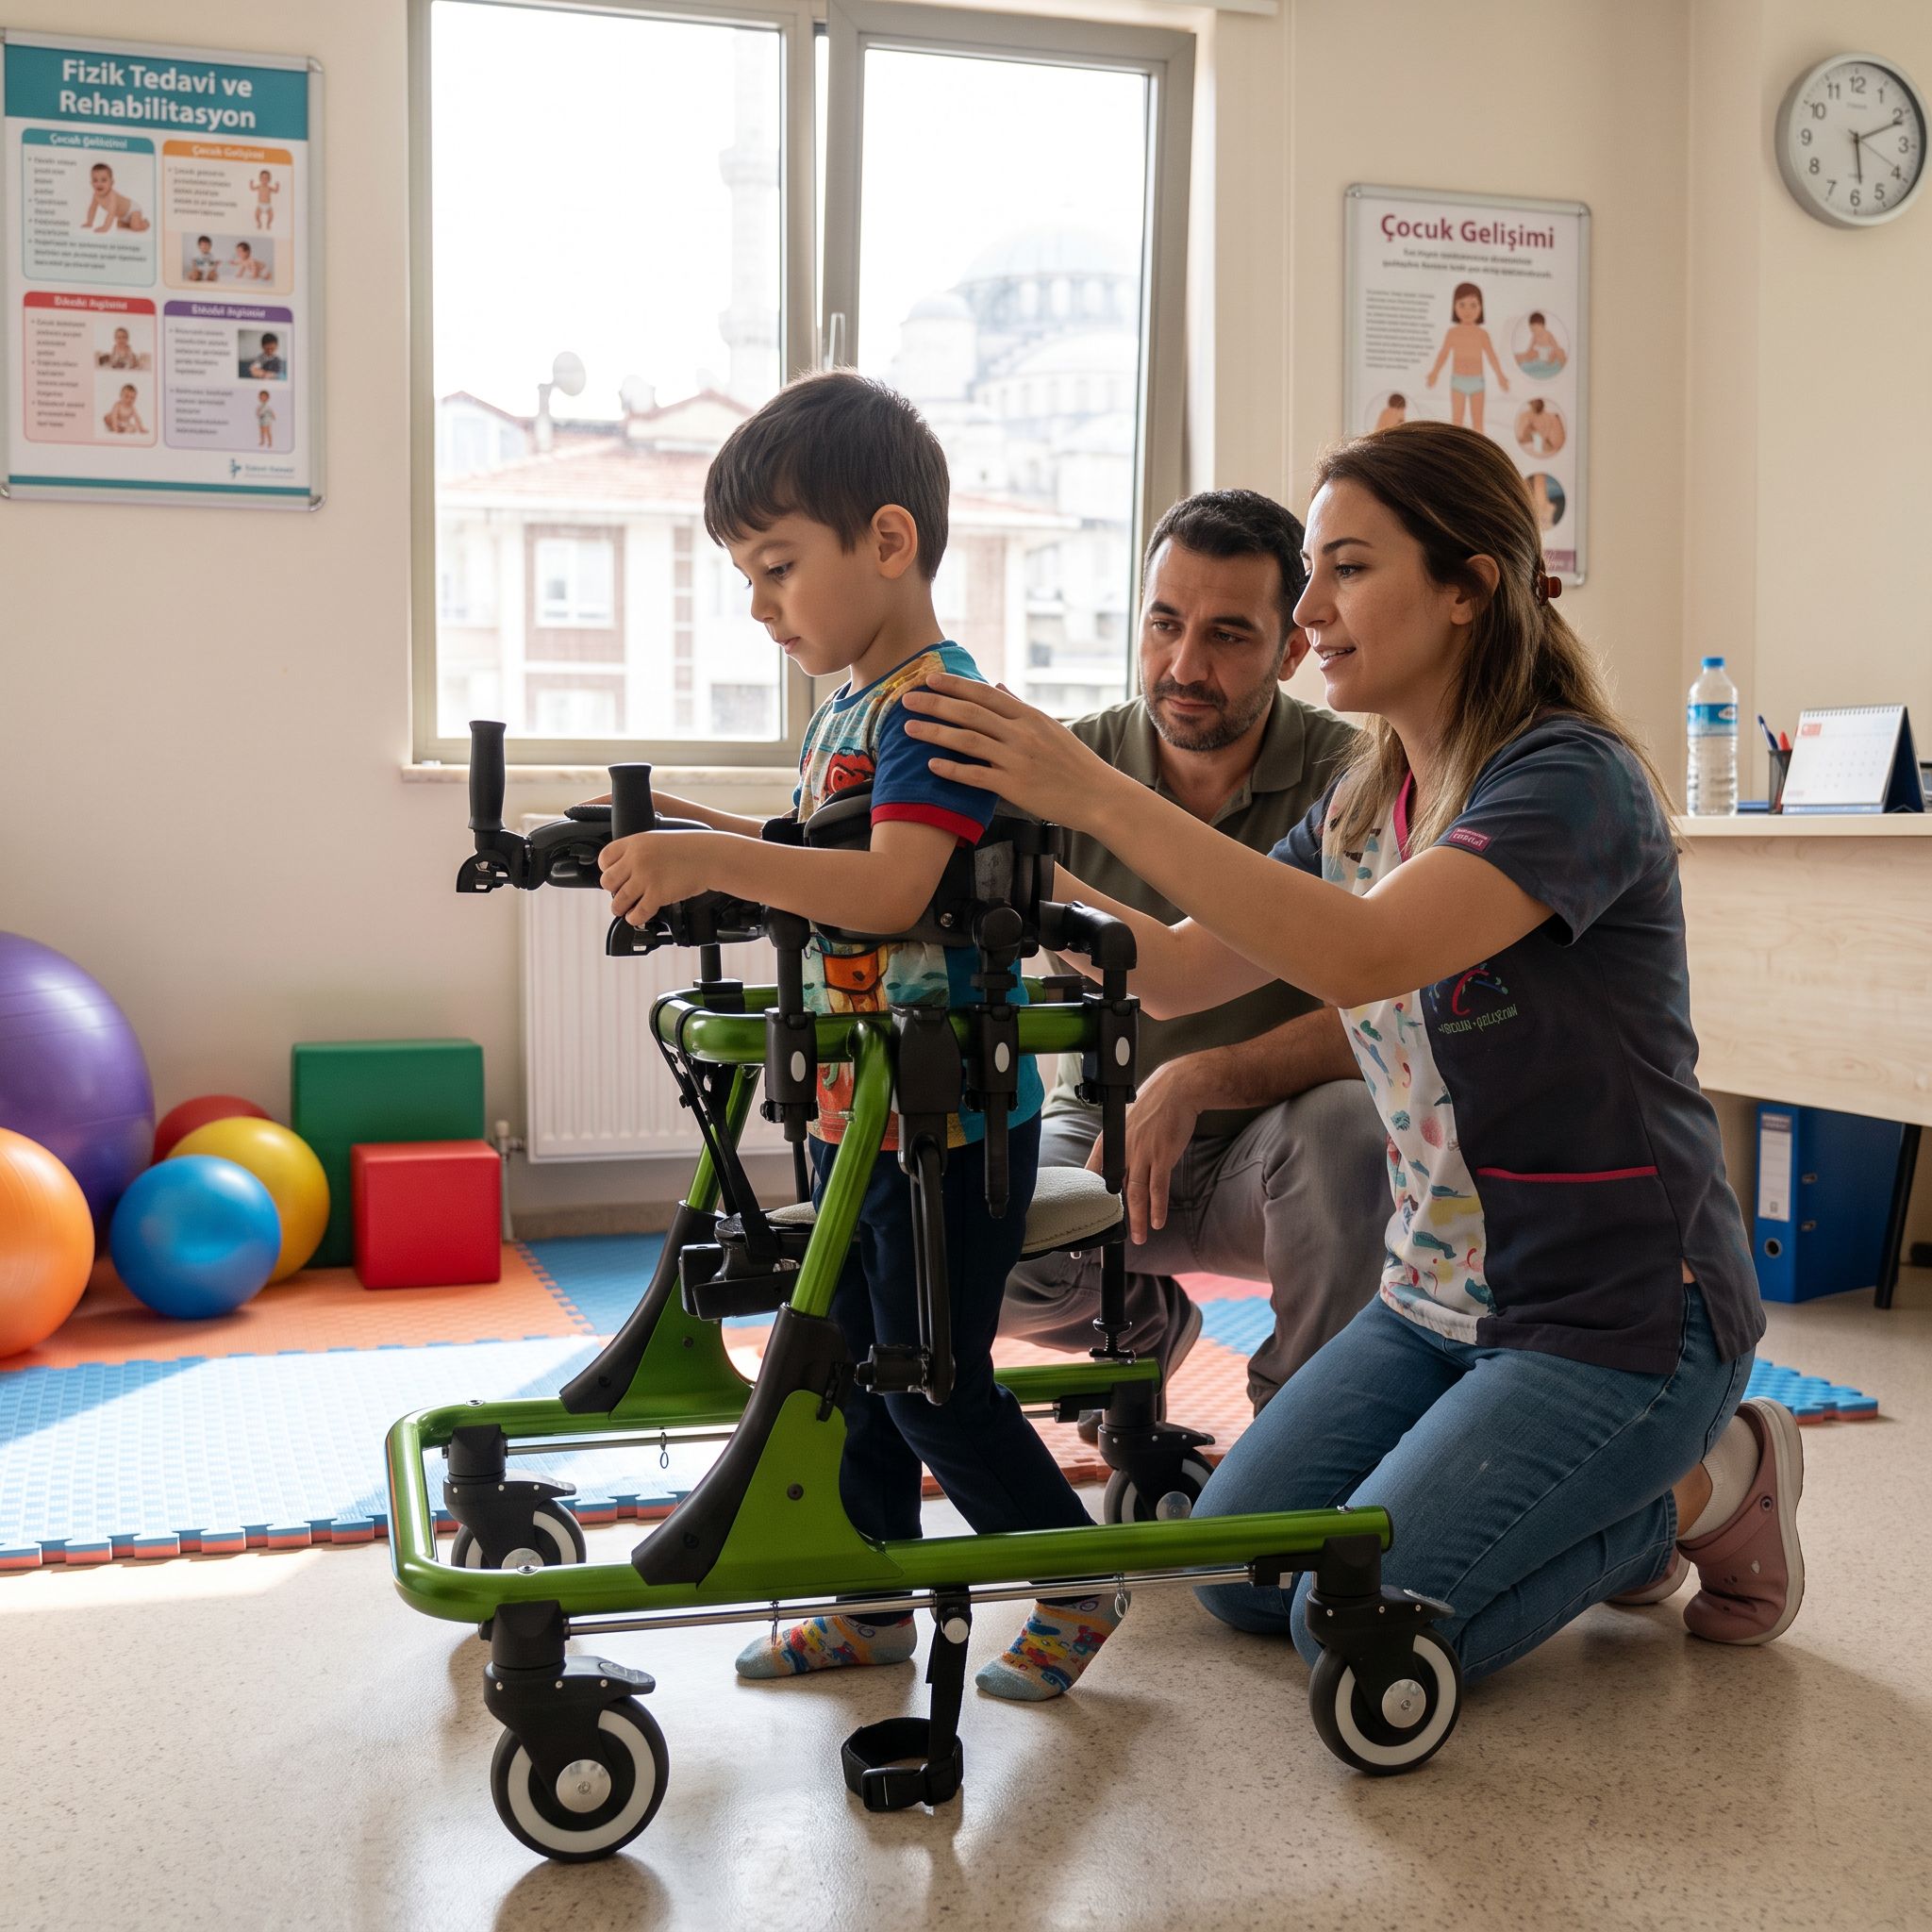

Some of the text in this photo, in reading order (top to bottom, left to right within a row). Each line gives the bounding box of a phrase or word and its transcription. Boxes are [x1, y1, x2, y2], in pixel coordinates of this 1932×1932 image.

[62, 58, 253, 97] Fizik Tedavi ve
[1849, 75, 1866, 94] 12
[1827, 82, 1840, 100] 11
[1877, 88, 1884, 104] 1
[59, 90, 257, 132] Rehabilitasyon
[1809, 102, 1826, 120] 10
[1892, 108, 1903, 125] 2
[1801, 128, 1812, 146] 9
[1898, 136, 1909, 154] 3
[1808, 158, 1820, 175] 8
[1890, 164, 1902, 180] 4
[1827, 179, 1837, 196] 7
[1874, 183, 1885, 200] 5
[1850, 189, 1861, 207] 6
[1381, 214, 1555, 251] Çocuk Gelişimi
